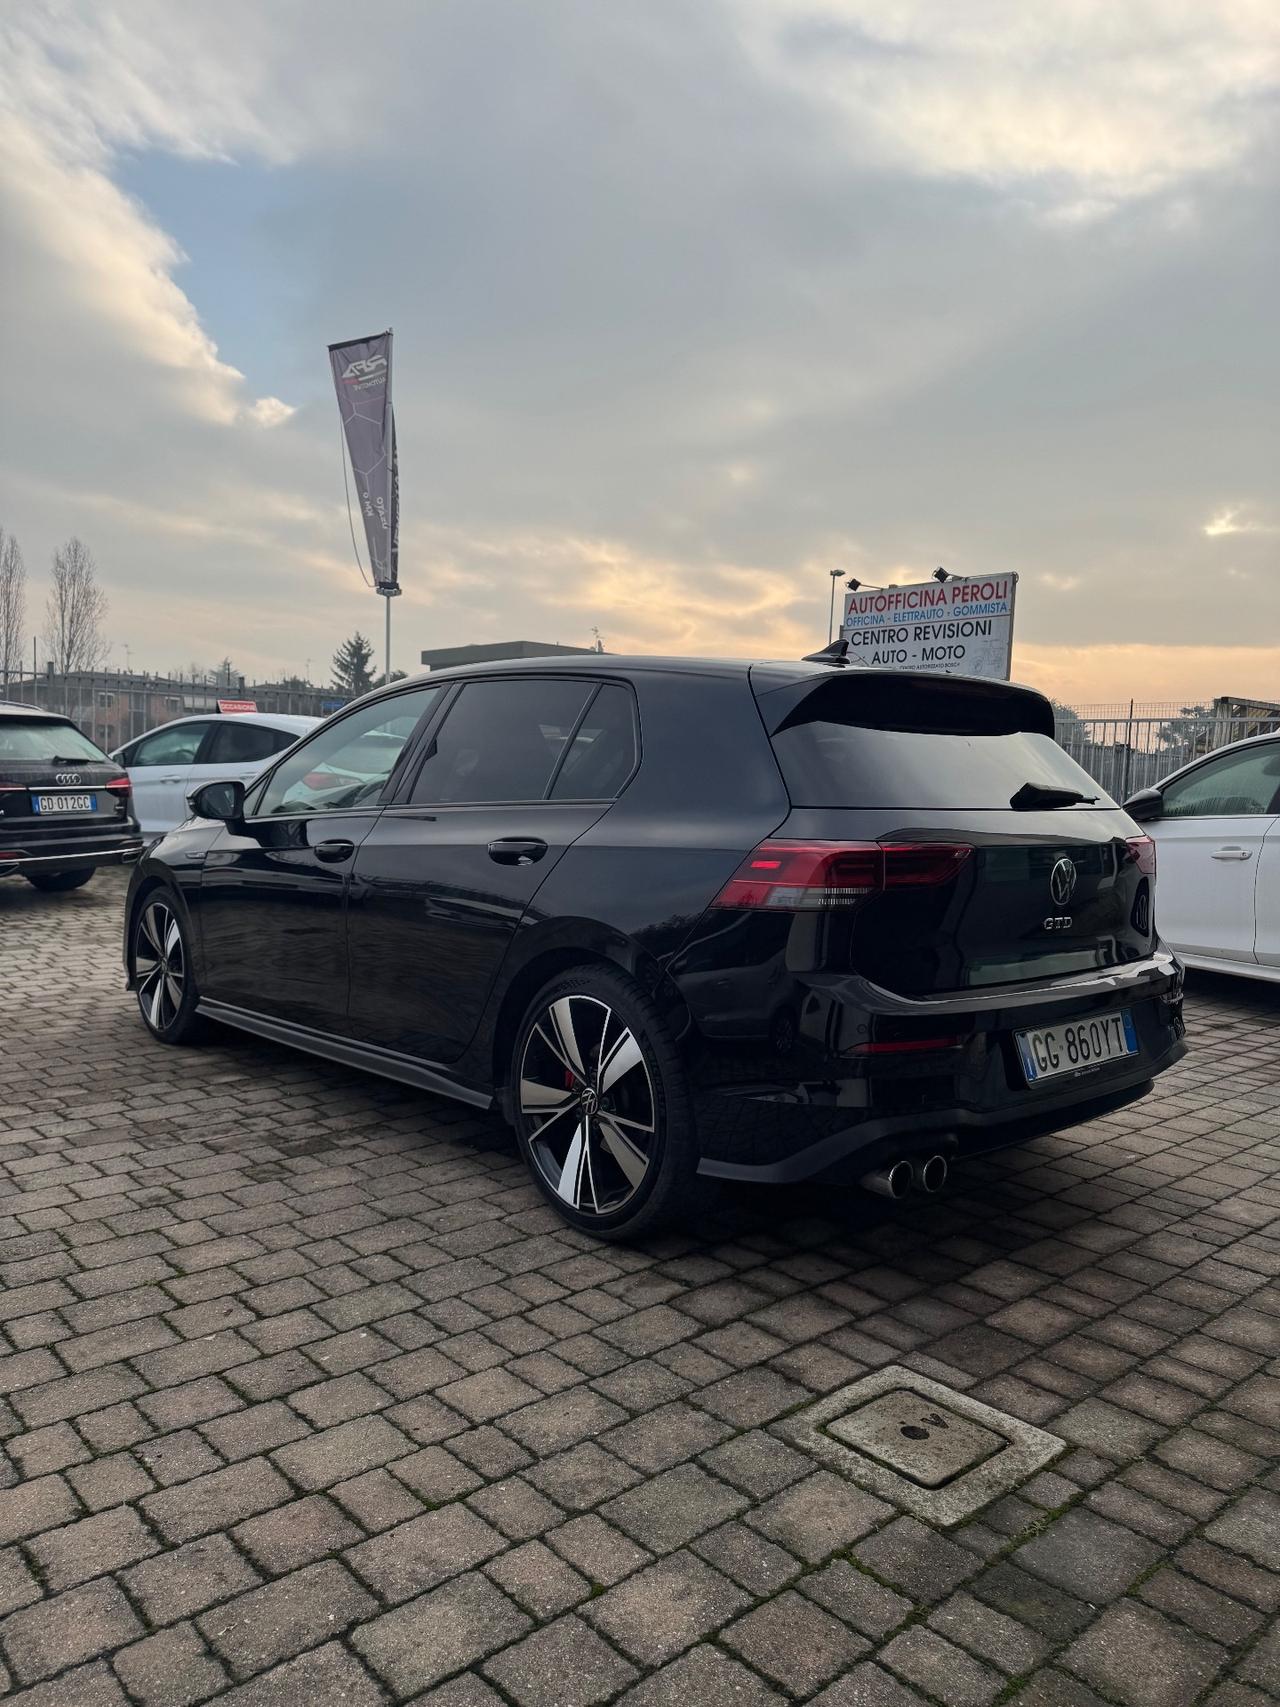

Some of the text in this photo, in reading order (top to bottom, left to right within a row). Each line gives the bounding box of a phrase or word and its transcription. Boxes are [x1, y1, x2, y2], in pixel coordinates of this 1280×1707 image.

[848, 581, 1008, 615] AUTOFFICINA PEROLI
[846, 612, 885, 627] OFFICINA
[893, 608, 944, 622] ELETTRAUTO
[953, 602, 1008, 617] GOMMISTA
[851, 620, 992, 646] CENTRO REVISIONI
[871, 649, 908, 665] AUTO
[921, 645, 966, 662] MOTO
[1044, 917, 1073, 930] GTD
